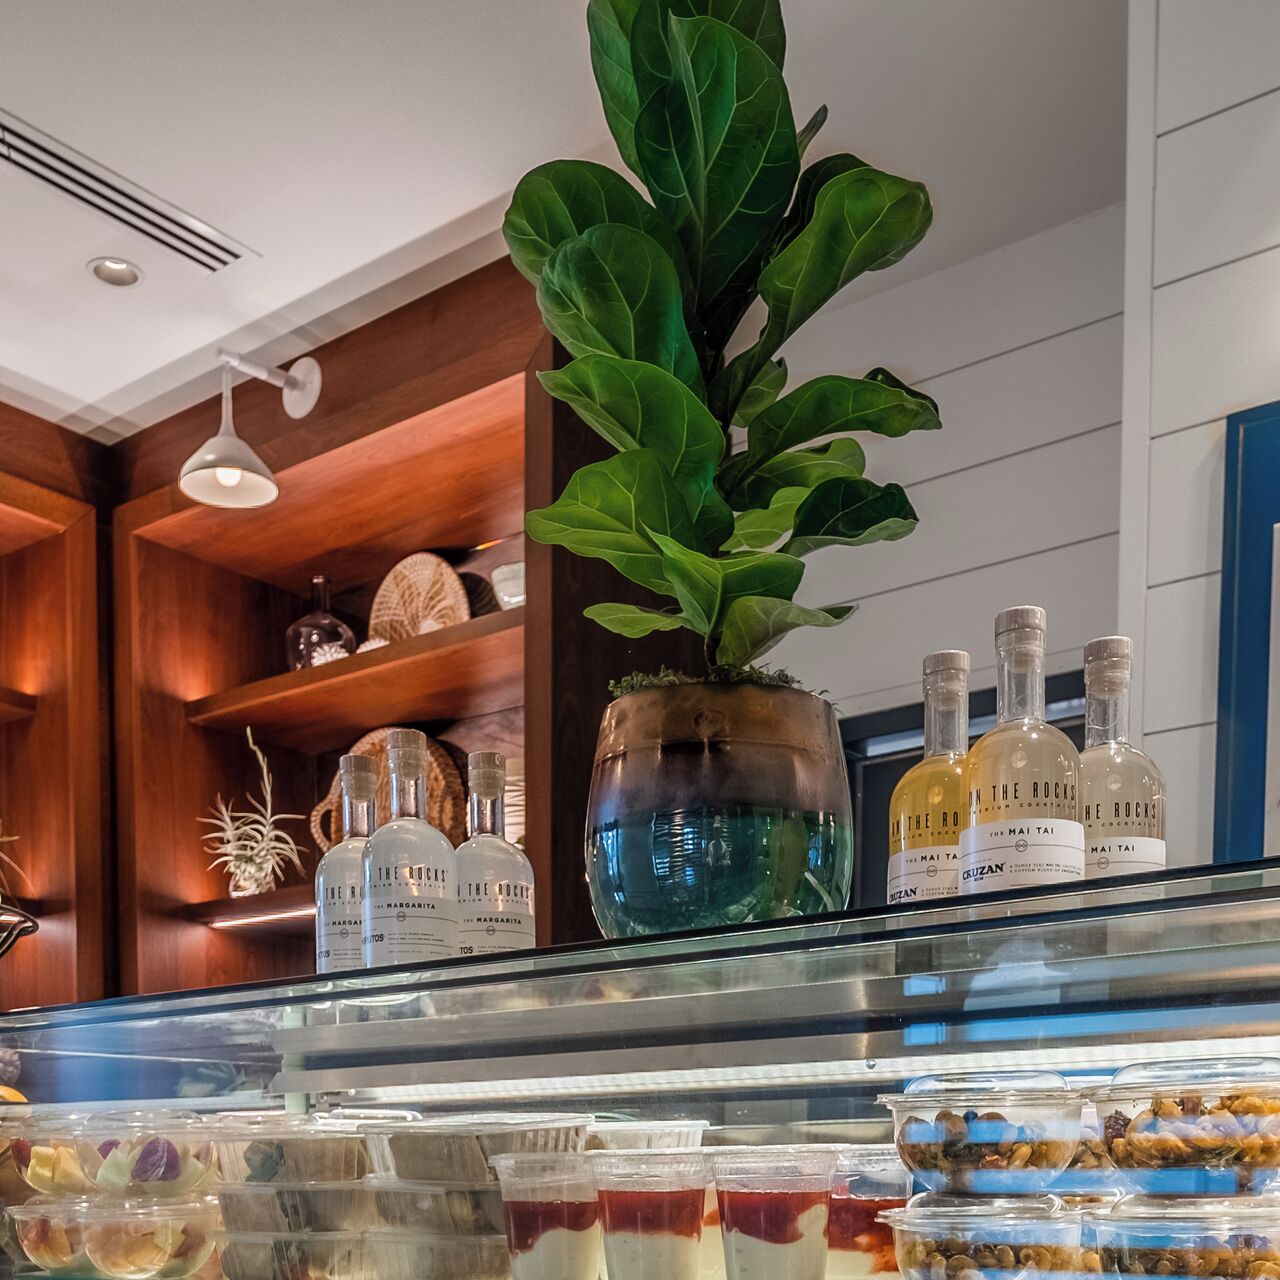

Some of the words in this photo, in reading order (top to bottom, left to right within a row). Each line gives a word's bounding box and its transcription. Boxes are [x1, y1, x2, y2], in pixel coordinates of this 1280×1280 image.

[992, 782, 1019, 803] THE
[1033, 780, 1075, 801] ROCKS
[1115, 802, 1157, 820] ROCKS
[908, 813, 930, 832] THE
[1009, 827, 1030, 836] MAI
[1036, 826, 1055, 835] TAI
[1091, 845, 1111, 854] MAI
[1117, 844, 1135, 853] TAI
[921, 854, 940, 862] MAI
[379, 866, 398, 881] THE
[409, 866, 447, 883] ROCKS
[962, 862, 1006, 881] CRUZAN
[326, 886, 342, 900] THE
[468, 883, 488, 897] THE
[498, 883, 530, 899] ROCKS
[387, 902, 436, 910] MARGARITA
[476, 917, 522, 925] MARGARITA
